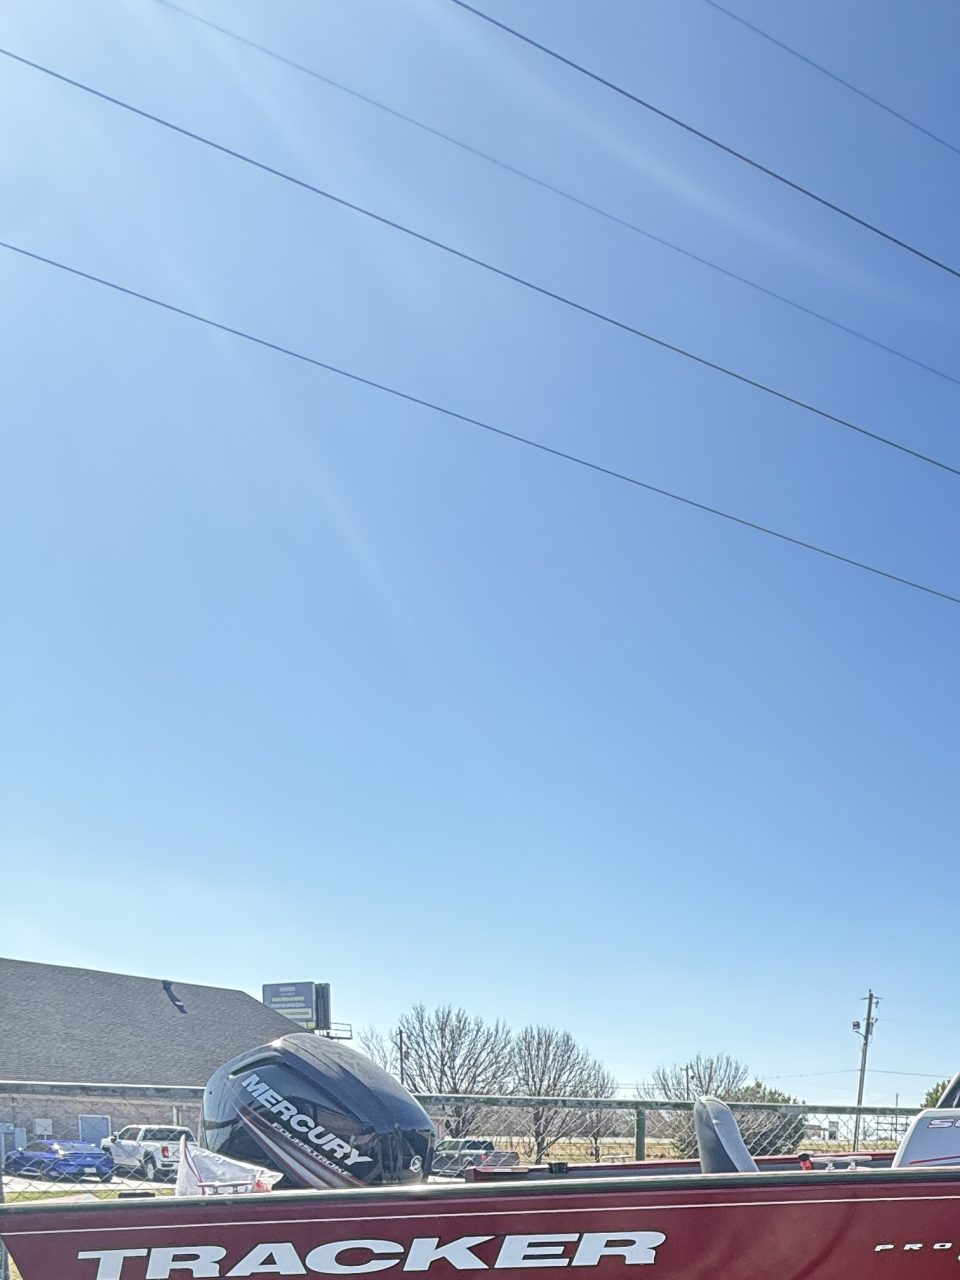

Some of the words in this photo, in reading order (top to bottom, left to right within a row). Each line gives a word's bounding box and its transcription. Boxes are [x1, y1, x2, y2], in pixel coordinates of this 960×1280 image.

[241, 1073, 374, 1166] MERCURY
[270, 1122, 353, 1177] FOURSTROKE
[874, 1242, 953, 1252] PRO
